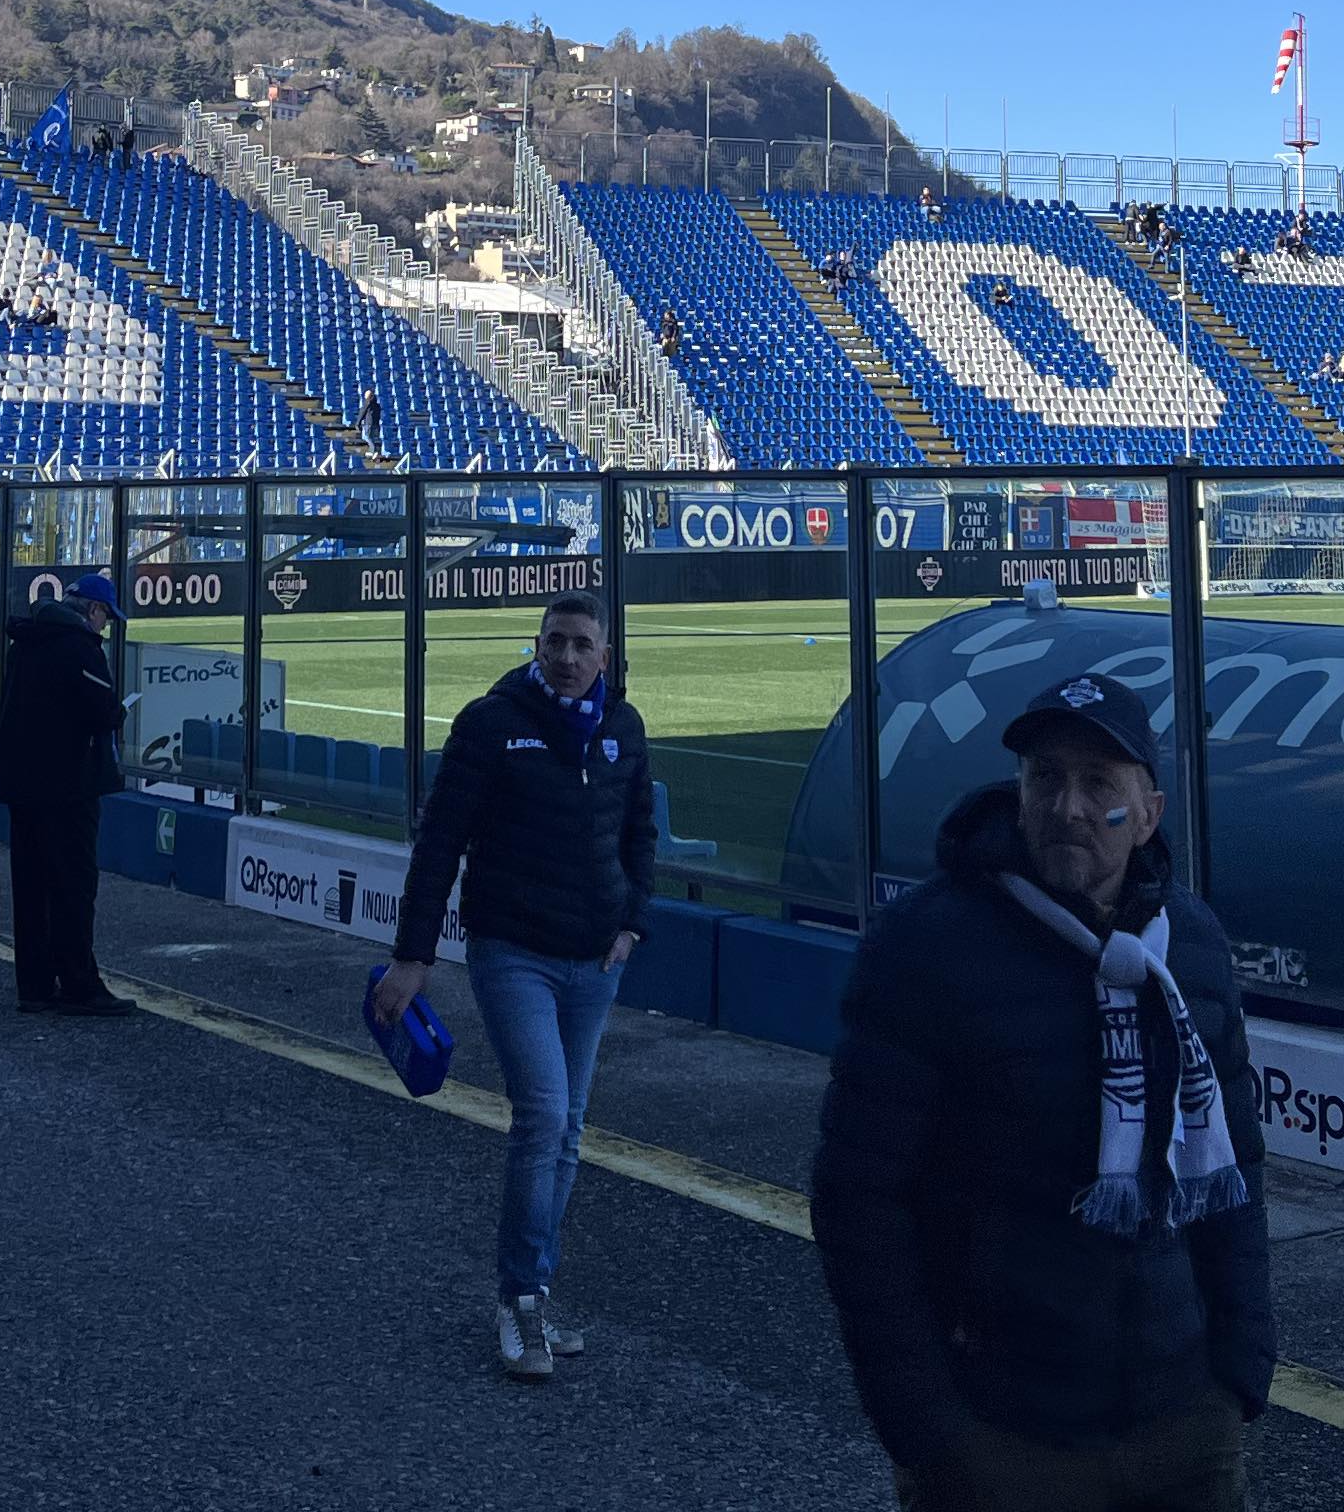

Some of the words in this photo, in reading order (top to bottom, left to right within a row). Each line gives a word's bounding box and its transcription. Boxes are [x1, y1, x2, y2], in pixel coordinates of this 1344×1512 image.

[958, 514, 982, 526] CHI
[963, 501, 988, 513] PAR
[680, 504, 794, 548] COMO
[875, 506, 917, 549] 07
[962, 526, 986, 538] CHE
[1076, 524, 1090, 533] 25
[1093, 523, 1142, 537] Maggio
[453, 568, 467, 599] IL
[471, 567, 504, 598] TUO
[508, 560, 587, 597] BIGLIETTO
[592, 559, 603, 587] S
[1001, 559, 1068, 587] ACQUISTA
[1070, 559, 1083, 586] IL
[1084, 558, 1111, 585] TUO
[134, 574, 222, 606] 00:00
[361, 889, 399, 926] INQUA
